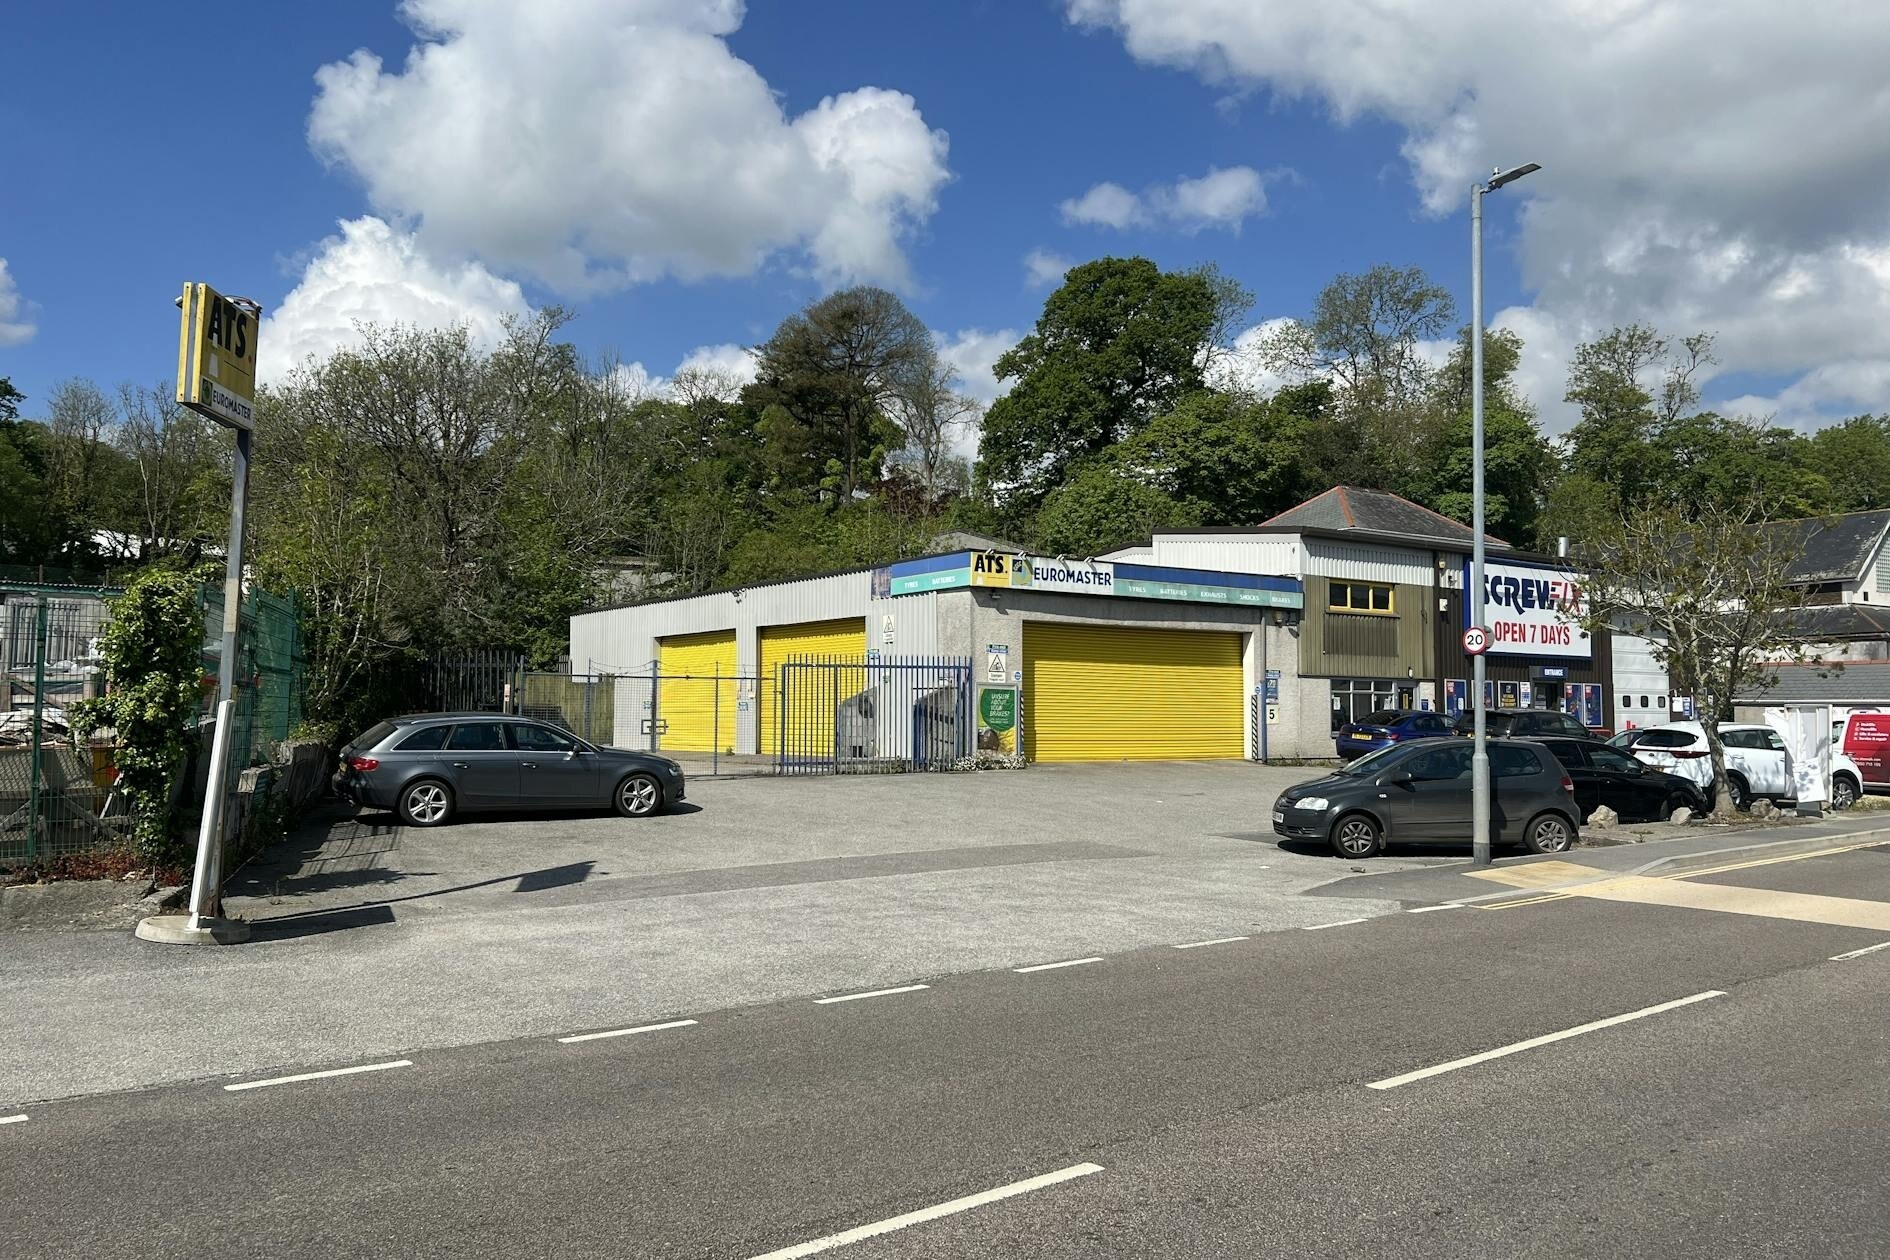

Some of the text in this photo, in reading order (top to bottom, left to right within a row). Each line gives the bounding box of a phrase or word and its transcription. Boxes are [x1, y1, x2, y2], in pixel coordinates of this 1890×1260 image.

[212, 390, 252, 420] EUROMASTER
[1033, 567, 1112, 586] EUROMASTER
[1128, 585, 1147, 593] TYRES
[1159, 588, 1188, 597] BATTERIES
[1200, 591, 1227, 599] EXHAUSTS
[1494, 621, 1570, 646] OPEN 7 DAYS
[1466, 634, 1483, 646] 20
[1269, 708, 1275, 720] 5
